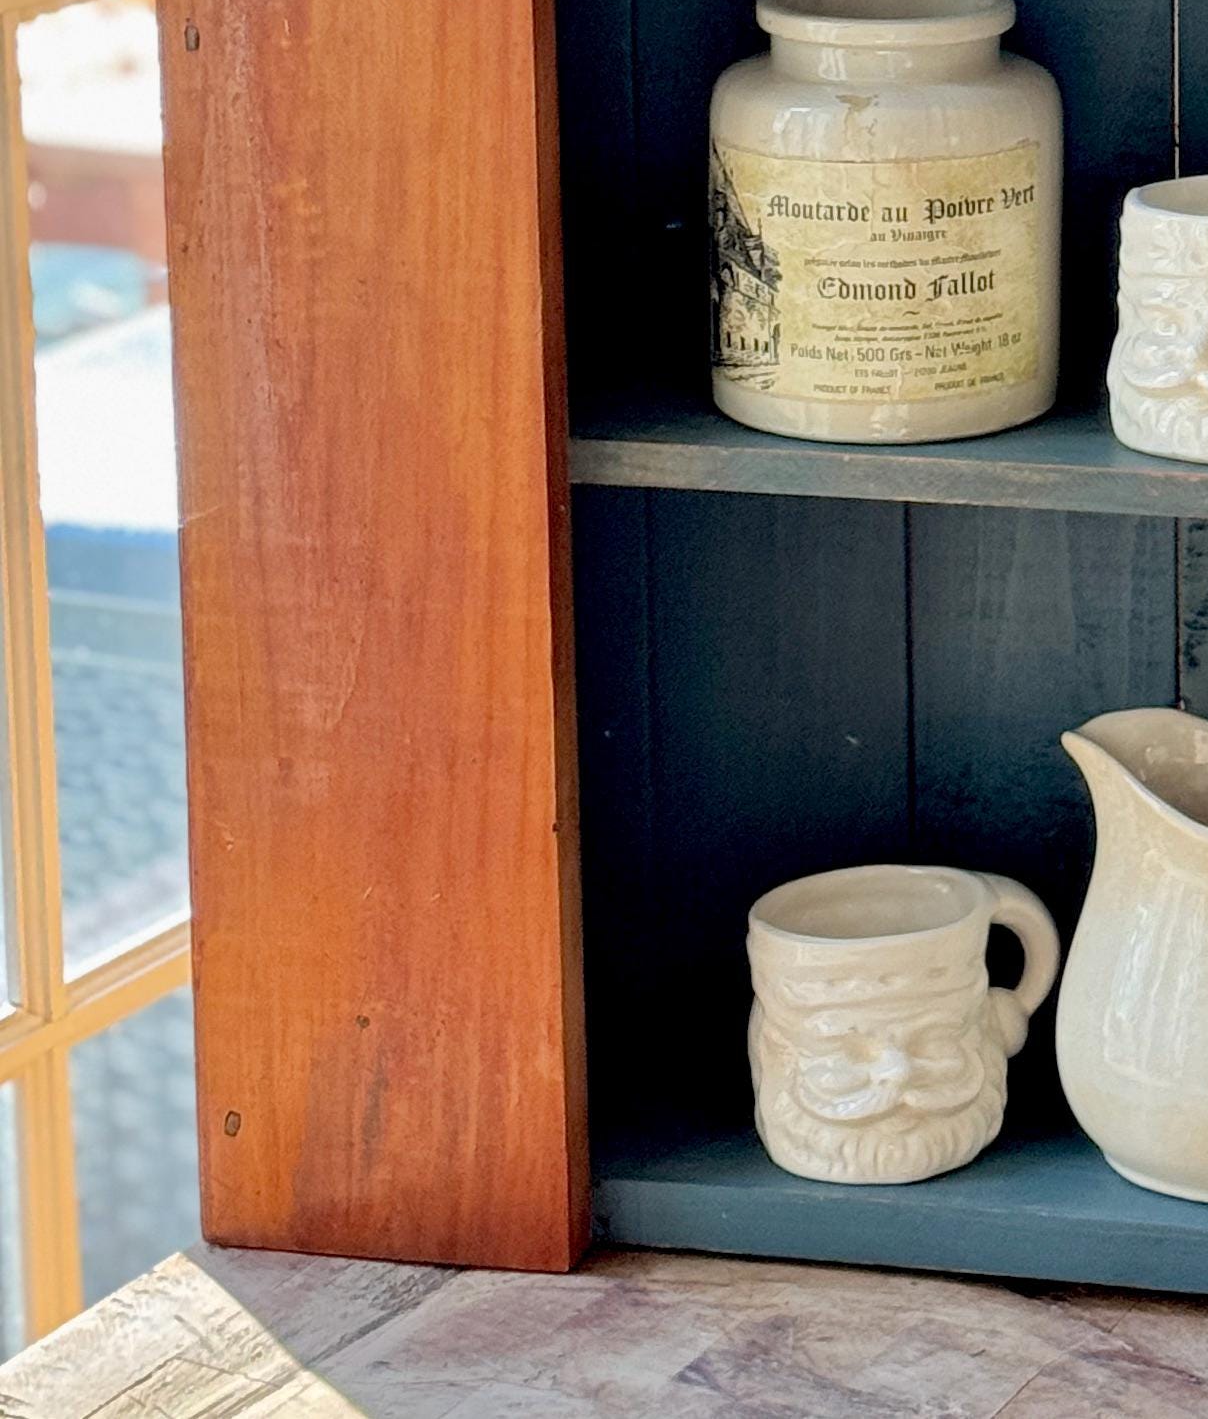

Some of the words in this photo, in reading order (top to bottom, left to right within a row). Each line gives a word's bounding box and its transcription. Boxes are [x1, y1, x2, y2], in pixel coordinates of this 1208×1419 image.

[766, 194, 870, 223] Moutarde
[881, 206, 908, 223] au
[922, 195, 995, 225] Poivre
[1001, 184, 1035, 210] Vert
[869, 231, 887, 242] au
[890, 228, 948, 242] Vinaigre
[817, 276, 916, 301] Edmond
[924, 269, 996, 302] Fallot
[790, 342, 823, 360] Poids
[856, 347, 886, 362] 500
[889, 347, 913, 362] Grs
[998, 332, 1010, 348] 18
